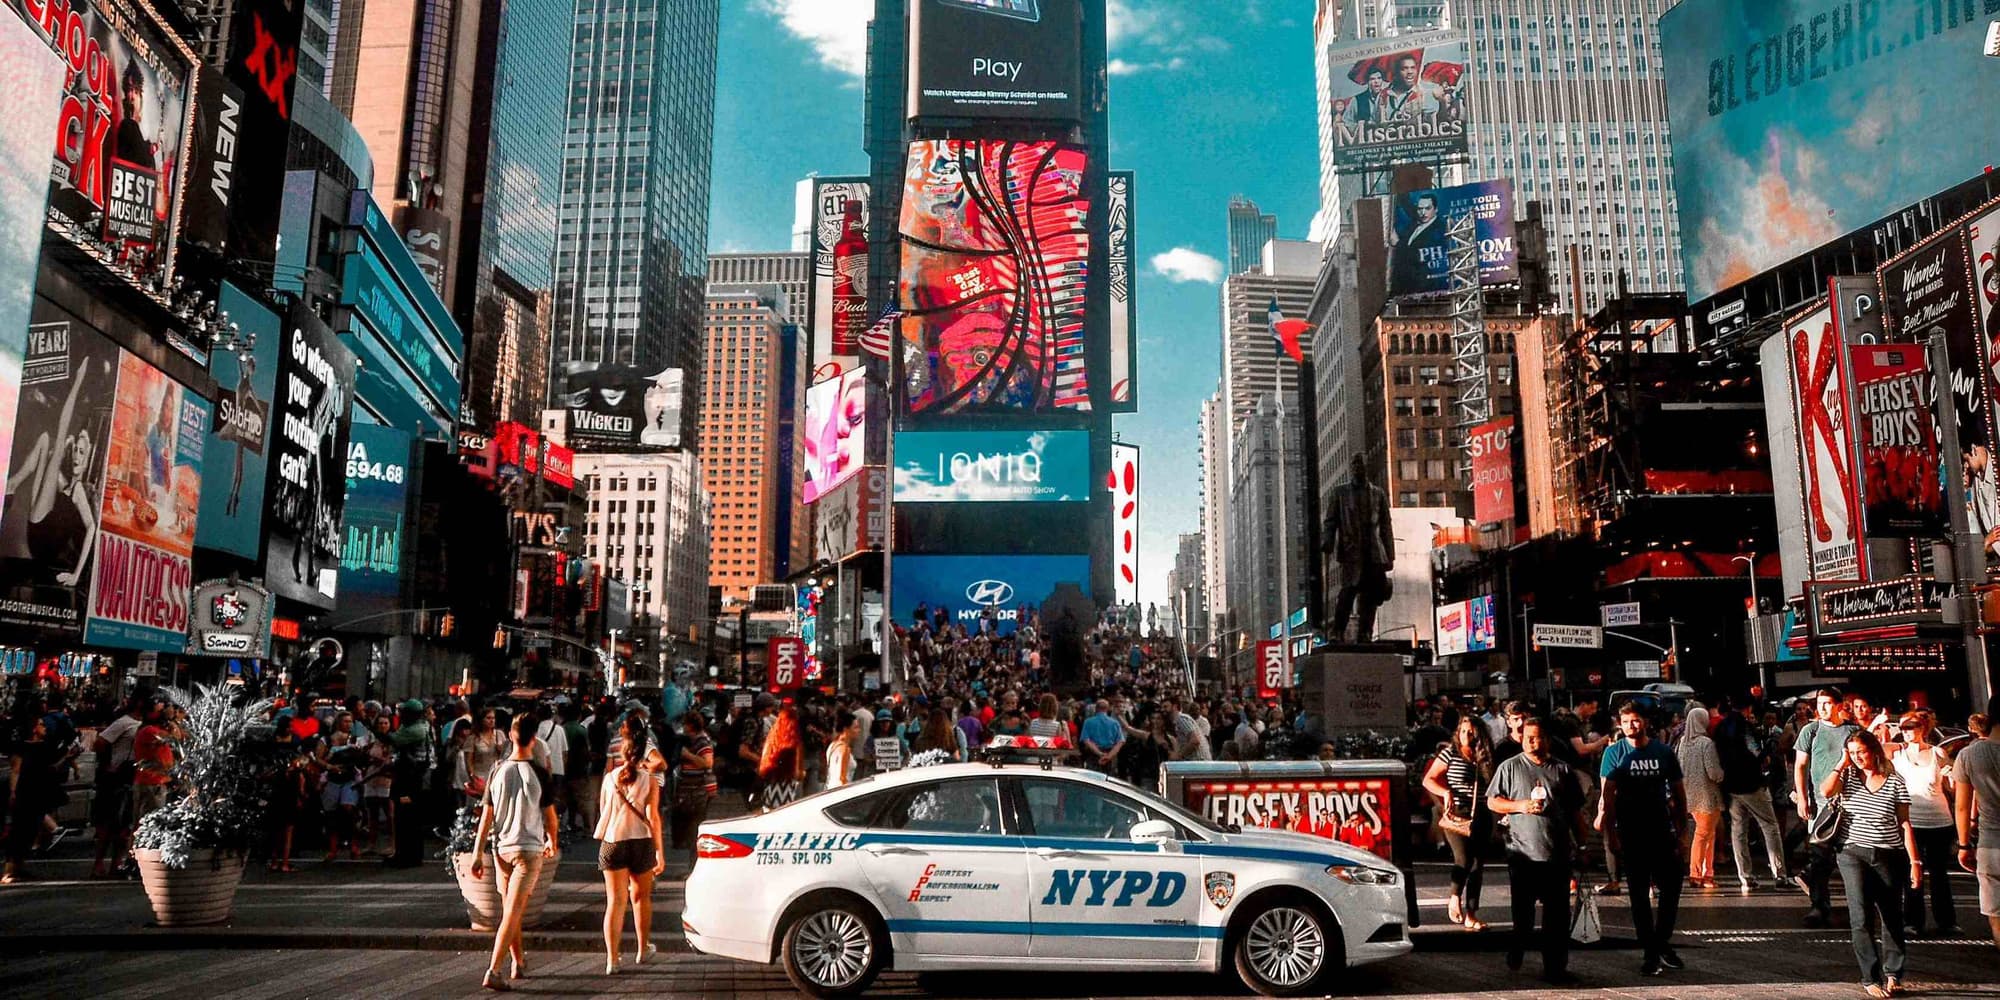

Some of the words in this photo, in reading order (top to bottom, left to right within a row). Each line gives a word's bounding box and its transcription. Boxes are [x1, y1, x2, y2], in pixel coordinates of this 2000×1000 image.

[115, 12, 149, 62] MESSAGE
[973, 58, 1022, 82] Play
[945, 90, 987, 98] Unbreakable
[987, 91, 1009, 99] Kimmy
[1010, 91, 1037, 99] Schmidt
[1334, 112, 1464, 147] Misérables
[211, 93, 239, 206] NEW
[111, 167, 155, 207] BEST
[109, 200, 154, 226] MUSICAL!
[952, 267, 980, 285] Best
[1903, 248, 1946, 292] Winner!
[1913, 288, 1925, 301] TONY
[1925, 277, 1944, 293] AWARDS
[1901, 309, 1922, 334] Best
[1923, 290, 1959, 320] Musical!
[29, 330, 67, 355] YEARS
[293, 329, 306, 365] Go
[287, 372, 312, 409] your
[1861, 374, 1926, 415] JERSEY
[182, 399, 207, 431] BEST
[219, 398, 263, 436] StubHub
[573, 409, 633, 432] WICKED
[1872, 408, 1922, 447] BOYS
[283, 412, 319, 455] routine
[279, 452, 308, 489] can't.
[939, 452, 1041, 482] IONIQ
[1033, 486, 1056, 494] SHOW
[95, 532, 190, 632] WAITRESS
[1536, 627, 1566, 635] PEDESTRIAN
[1561, 636, 1573, 644] KEEP
[1573, 637, 1593, 645] MOVING
[776, 641, 798, 685] tkts
[1630, 759, 1659, 770] ANU
[1309, 791, 1382, 836] BOYS
[755, 832, 861, 850] TRAFFIC
[792, 853, 810, 865] SPL
[814, 853, 832, 865] OPS
[907, 890, 952, 902] RESPECT
[1042, 870, 1187, 907] NYPD
